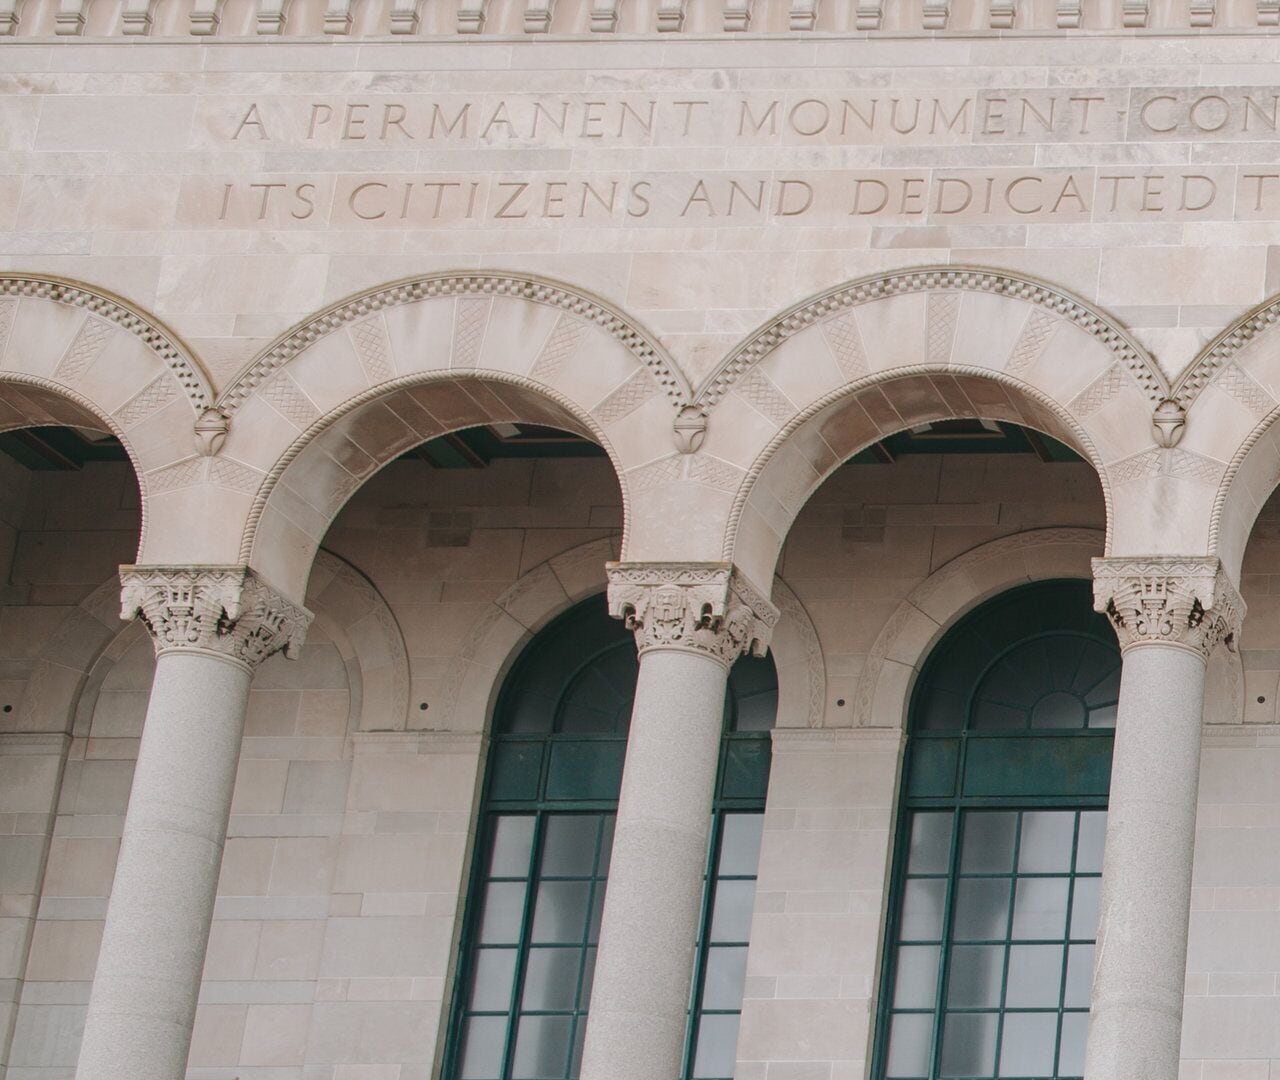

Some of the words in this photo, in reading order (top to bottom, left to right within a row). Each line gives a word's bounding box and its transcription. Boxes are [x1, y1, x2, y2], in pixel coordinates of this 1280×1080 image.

[232, 102, 269, 141] A
[306, 100, 709, 141] PERMANENT
[735, 96, 1105, 138] MONUMENT
[219, 182, 315, 221] ITS
[347, 178, 652, 220] CITIZENS
[680, 178, 815, 218] AND
[849, 174, 1218, 217] DEDICATED
